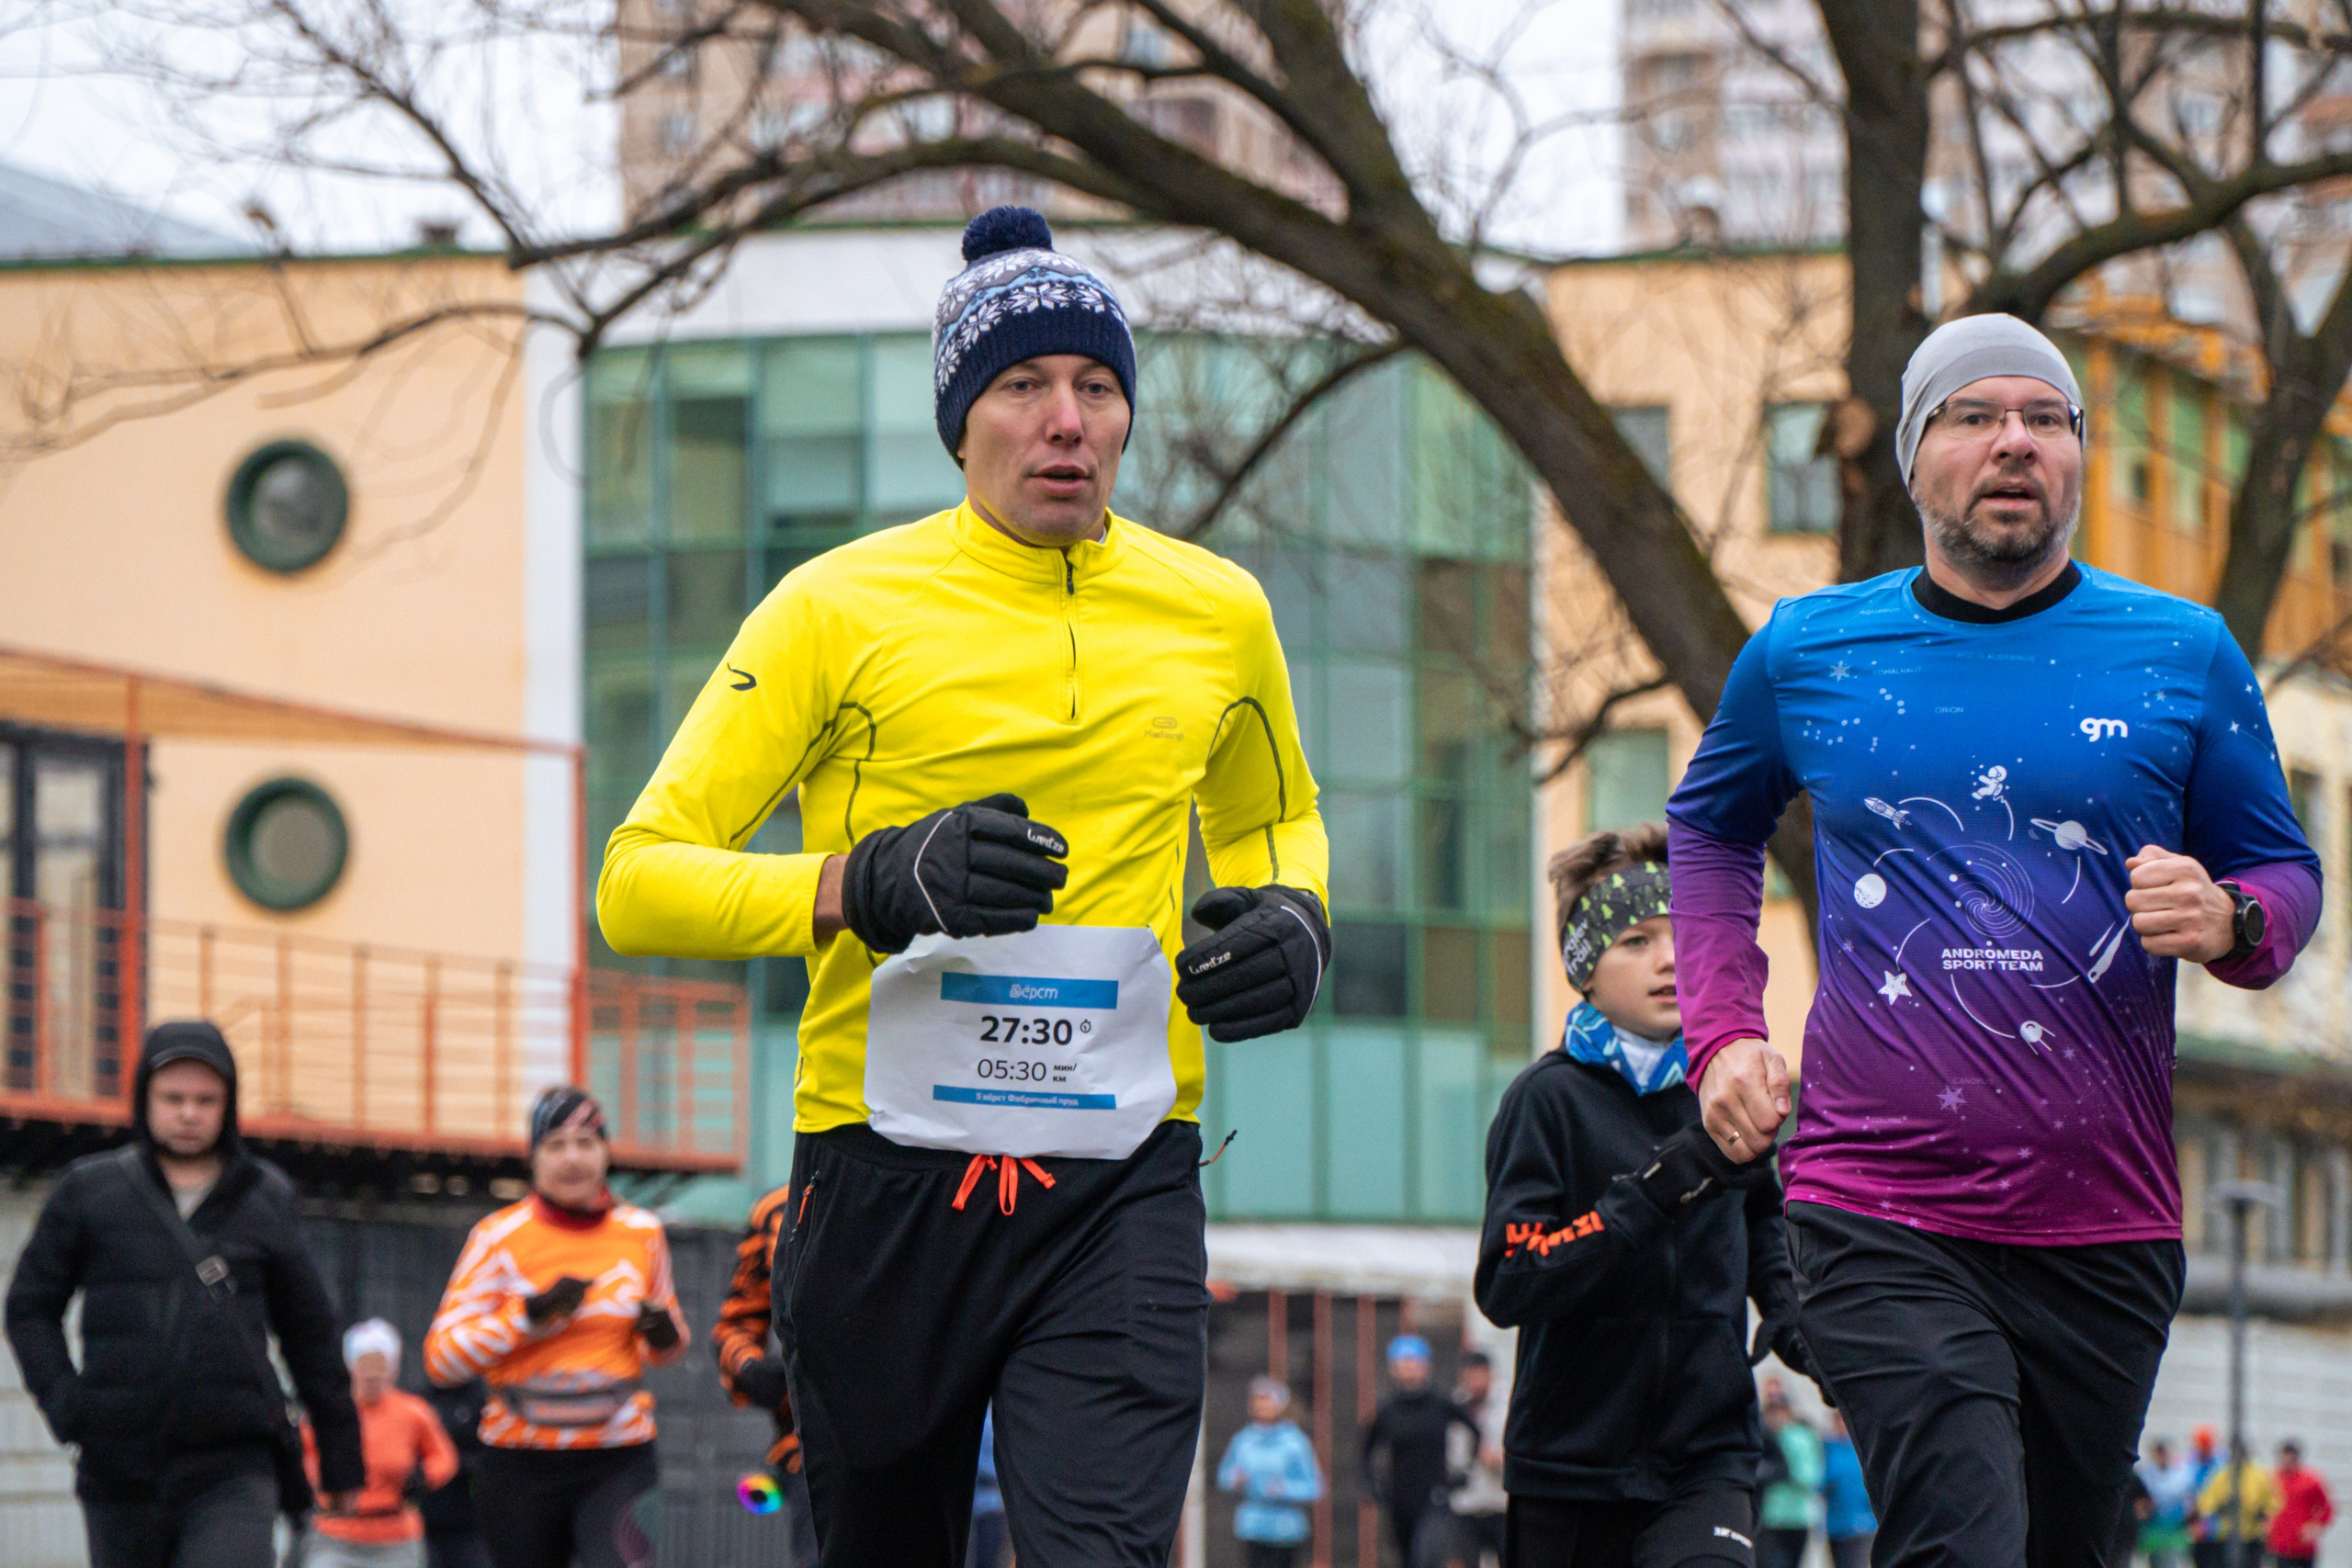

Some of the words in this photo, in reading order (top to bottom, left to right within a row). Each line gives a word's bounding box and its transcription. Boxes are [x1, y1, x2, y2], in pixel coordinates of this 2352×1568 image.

[1941, 948, 2043, 960] ANDROMEDA
[1942, 960, 1995, 970] SPORT
[1997, 961, 2043, 971] TEAM
[980, 1016, 1072, 1045] 27:30
[978, 1059, 1046, 1081] 05:30
[976, 1092, 981, 1100] 5
[983, 1093, 1005, 1102] вёрст
[1058, 1098, 1079, 1107] пруд
